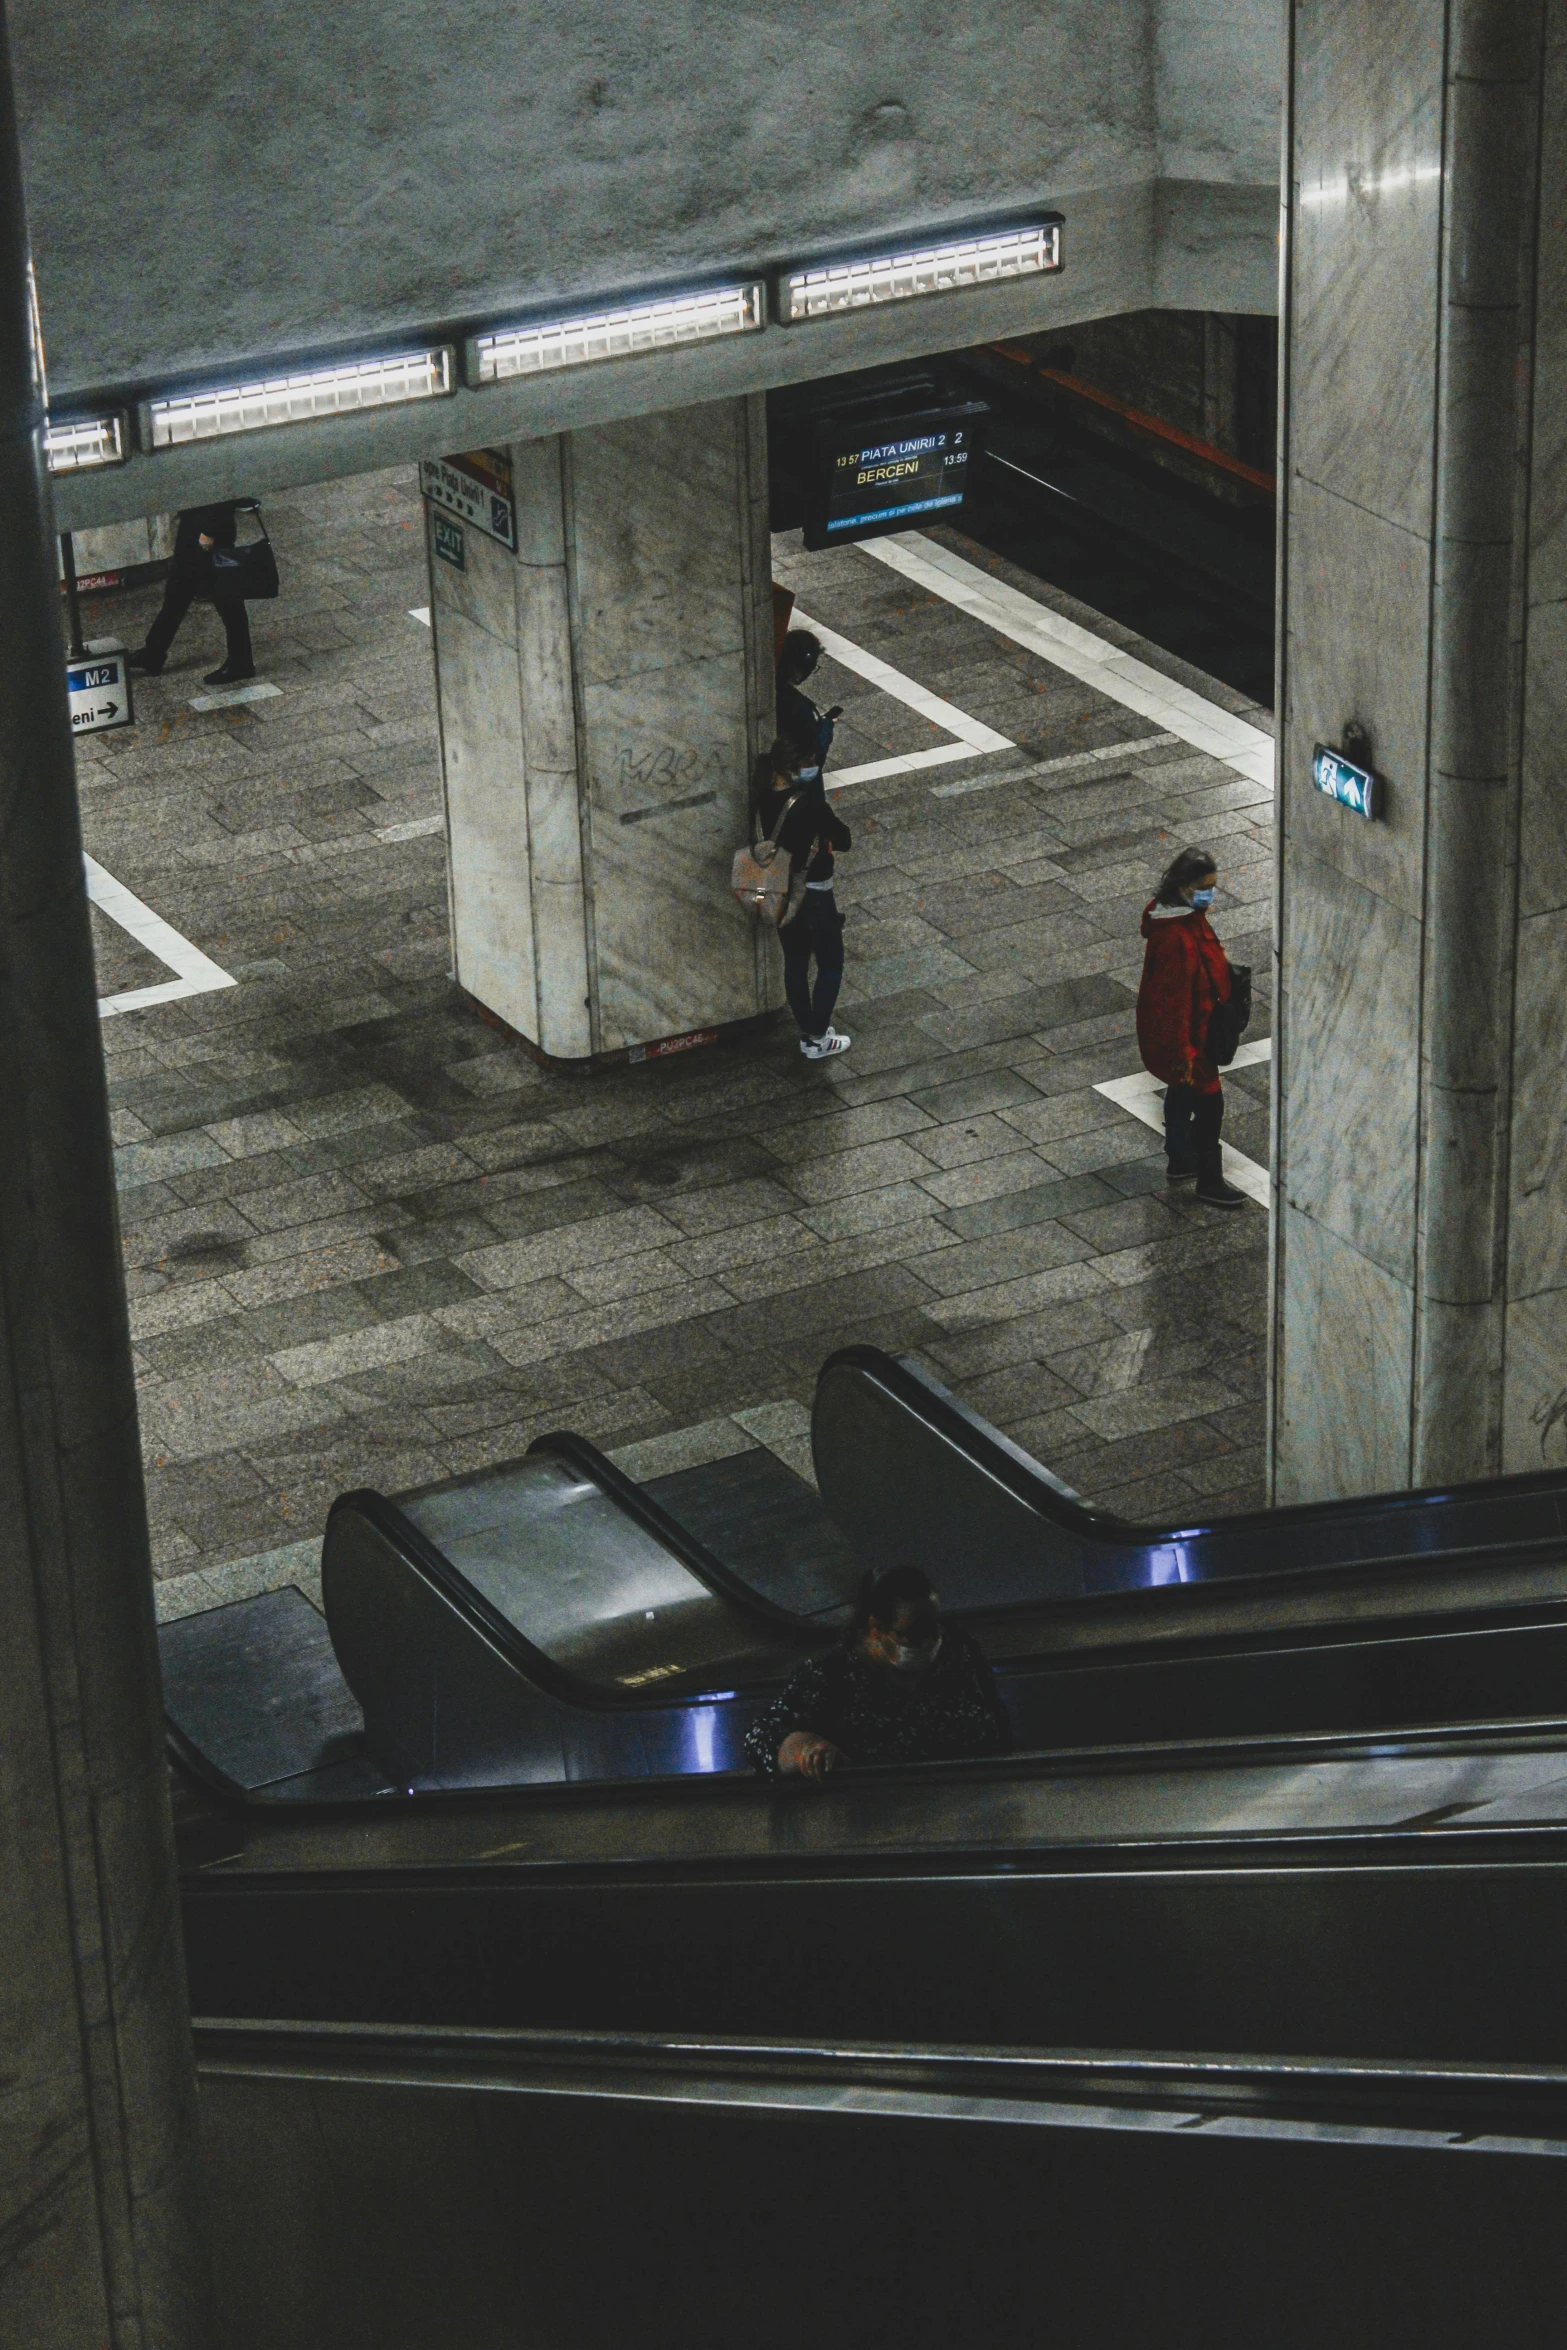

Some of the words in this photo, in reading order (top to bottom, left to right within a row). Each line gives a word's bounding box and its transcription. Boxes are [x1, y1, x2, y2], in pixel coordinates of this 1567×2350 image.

[861, 446, 896, 462] PIATA
[900, 437, 935, 454] UNIRII
[938, 435, 946, 446] 2
[954, 432, 963, 444] 2
[857, 461, 919, 484] BERCENI
[944, 452, 968, 466] 13:59
[436, 521, 461, 552] EXIT
[85, 669, 110, 687] M2
